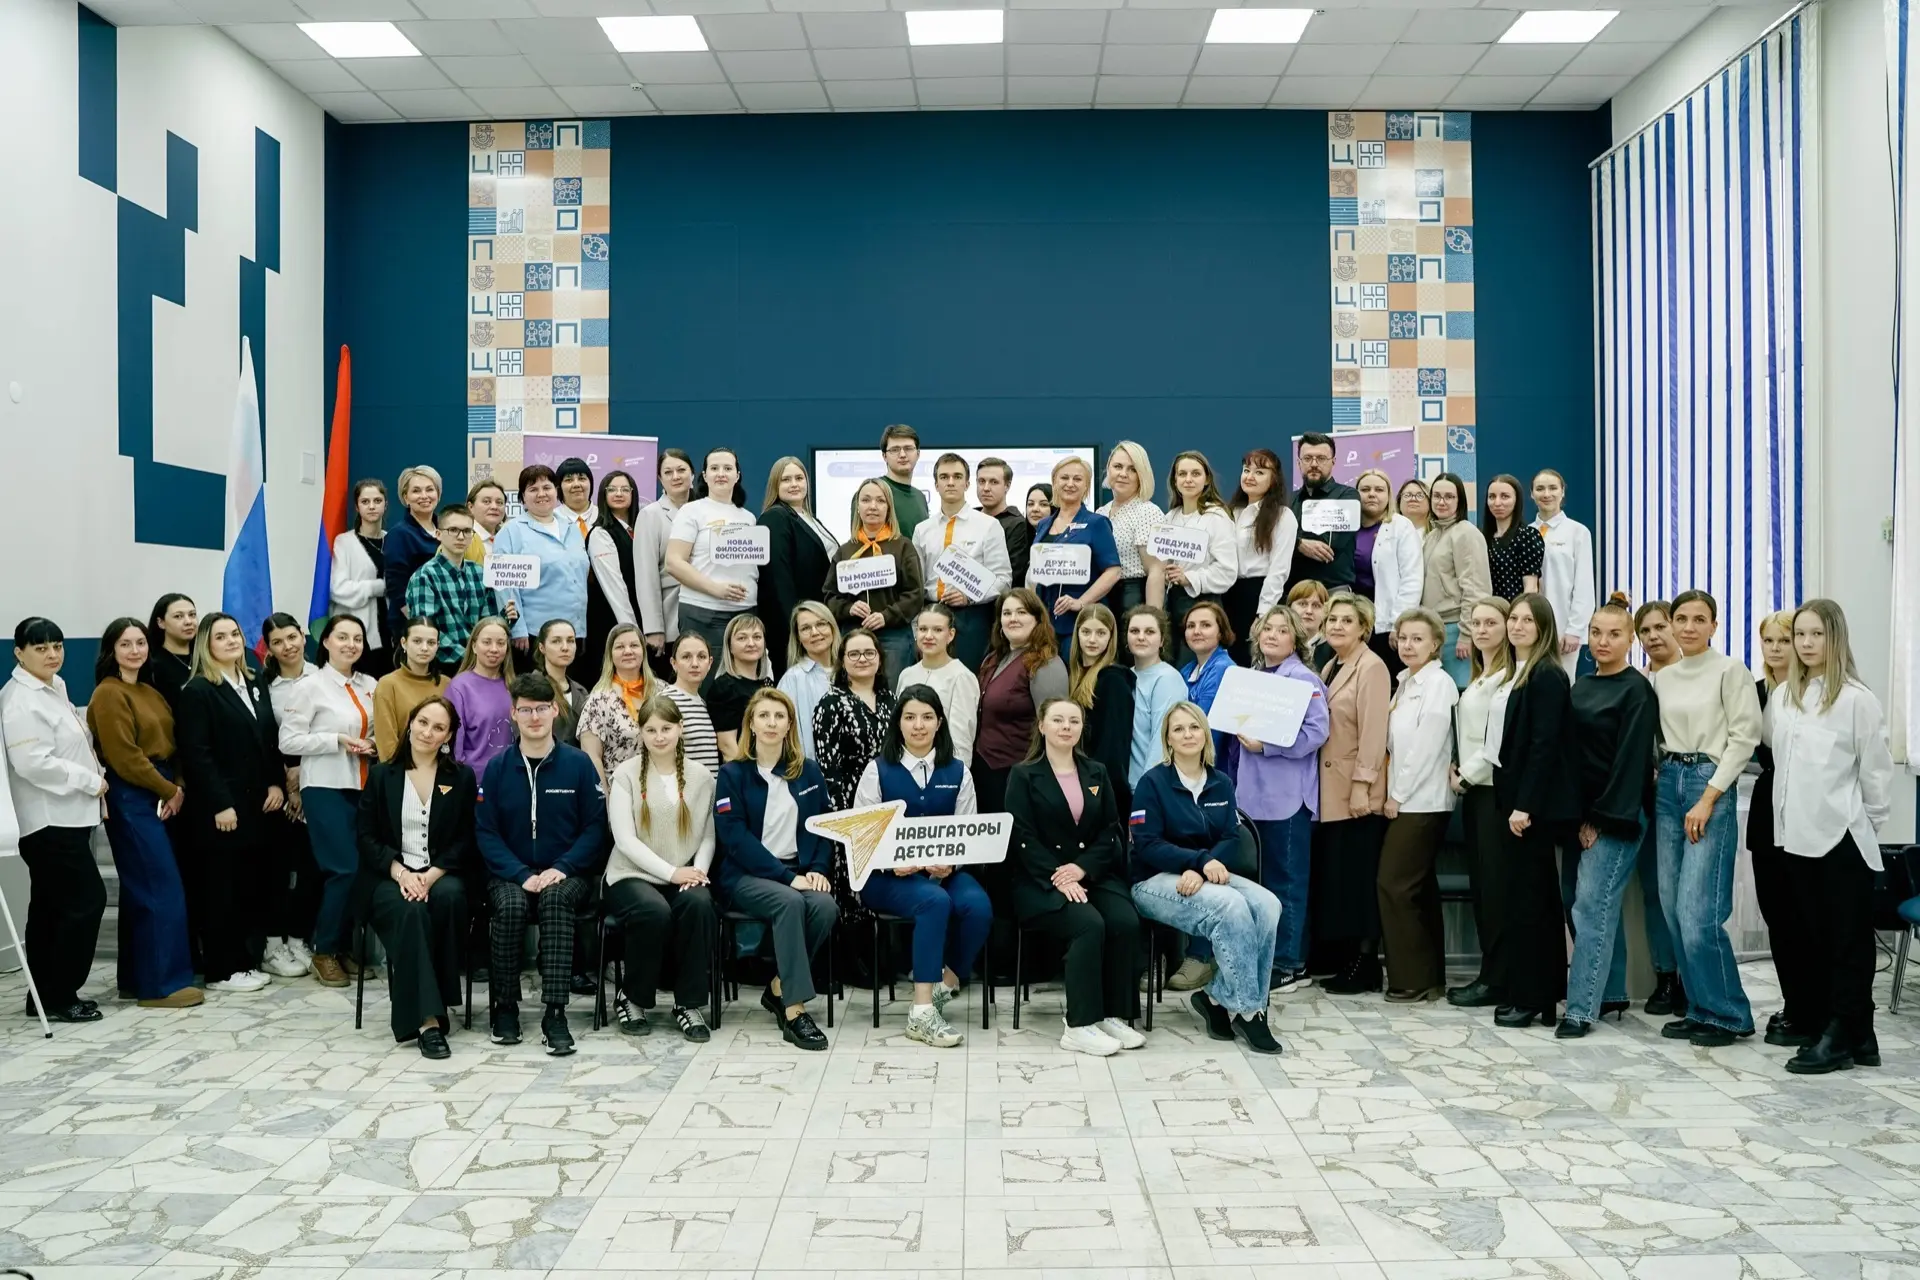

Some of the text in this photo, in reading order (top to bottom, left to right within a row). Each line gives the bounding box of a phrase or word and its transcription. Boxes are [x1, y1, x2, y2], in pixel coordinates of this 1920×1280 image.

[1157, 546, 1196, 559] МЕЧТОЙ!
[1190, 543, 1202, 551] ЗА
[496, 571, 527, 579] ТОЛЬКО
[948, 560, 982, 586] ДЕЛАЕМ
[1033, 567, 1087, 576] НАСТАВНИК
[839, 574, 852, 582] ТЫ
[848, 578, 887, 590] БОЛЬШЕ!
[936, 562, 983, 598] МИР ЛУЧШЕ!
[895, 822, 1001, 841] НАВИГАТОРЫ
[894, 842, 966, 862] ДЕТСТВА
